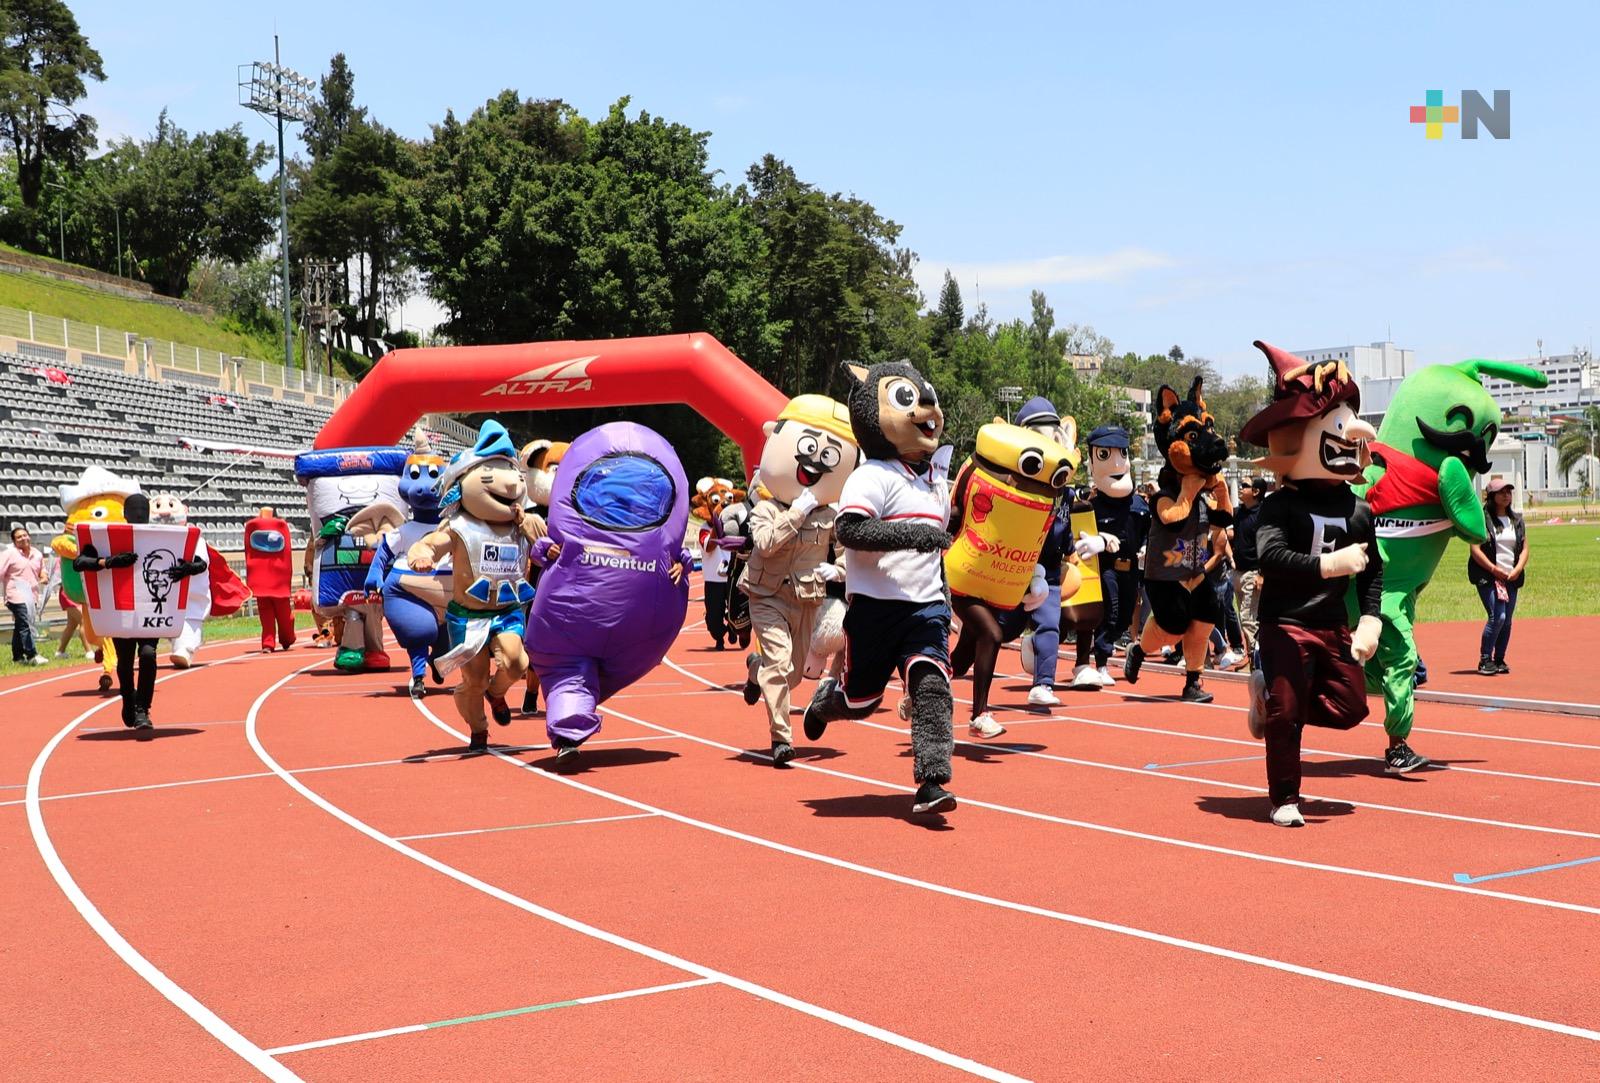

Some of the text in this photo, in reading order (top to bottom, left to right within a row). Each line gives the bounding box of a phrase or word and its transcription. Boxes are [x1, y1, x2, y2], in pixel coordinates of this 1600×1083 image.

[480, 379, 593, 396] ALTRA
[580, 551, 657, 573] Juventud
[990, 560, 1015, 574] MOLE
[142, 616, 174, 628] KFC
